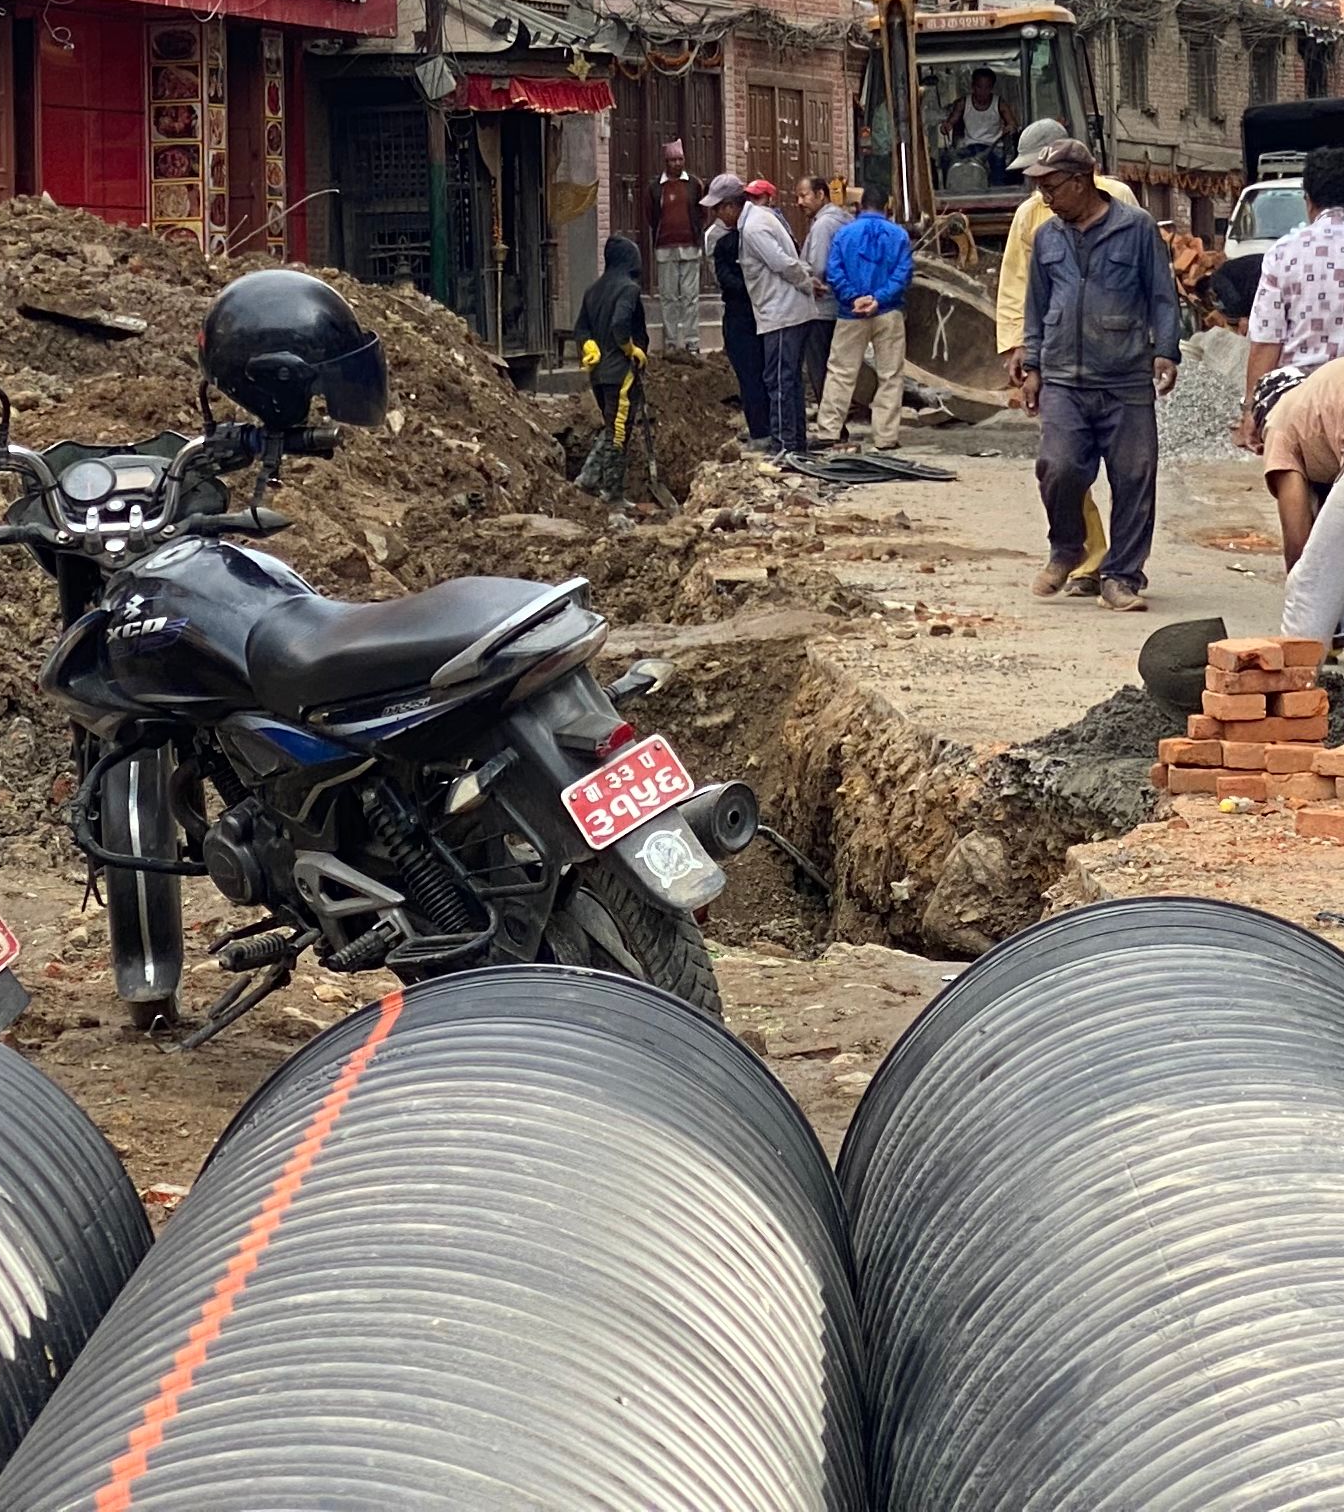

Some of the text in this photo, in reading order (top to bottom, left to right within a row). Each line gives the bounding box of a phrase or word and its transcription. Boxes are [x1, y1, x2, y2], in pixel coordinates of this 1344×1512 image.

[605, 764, 636, 790] ३३
[637, 751, 656, 769] प
[584, 766, 686, 838] ३१५६
